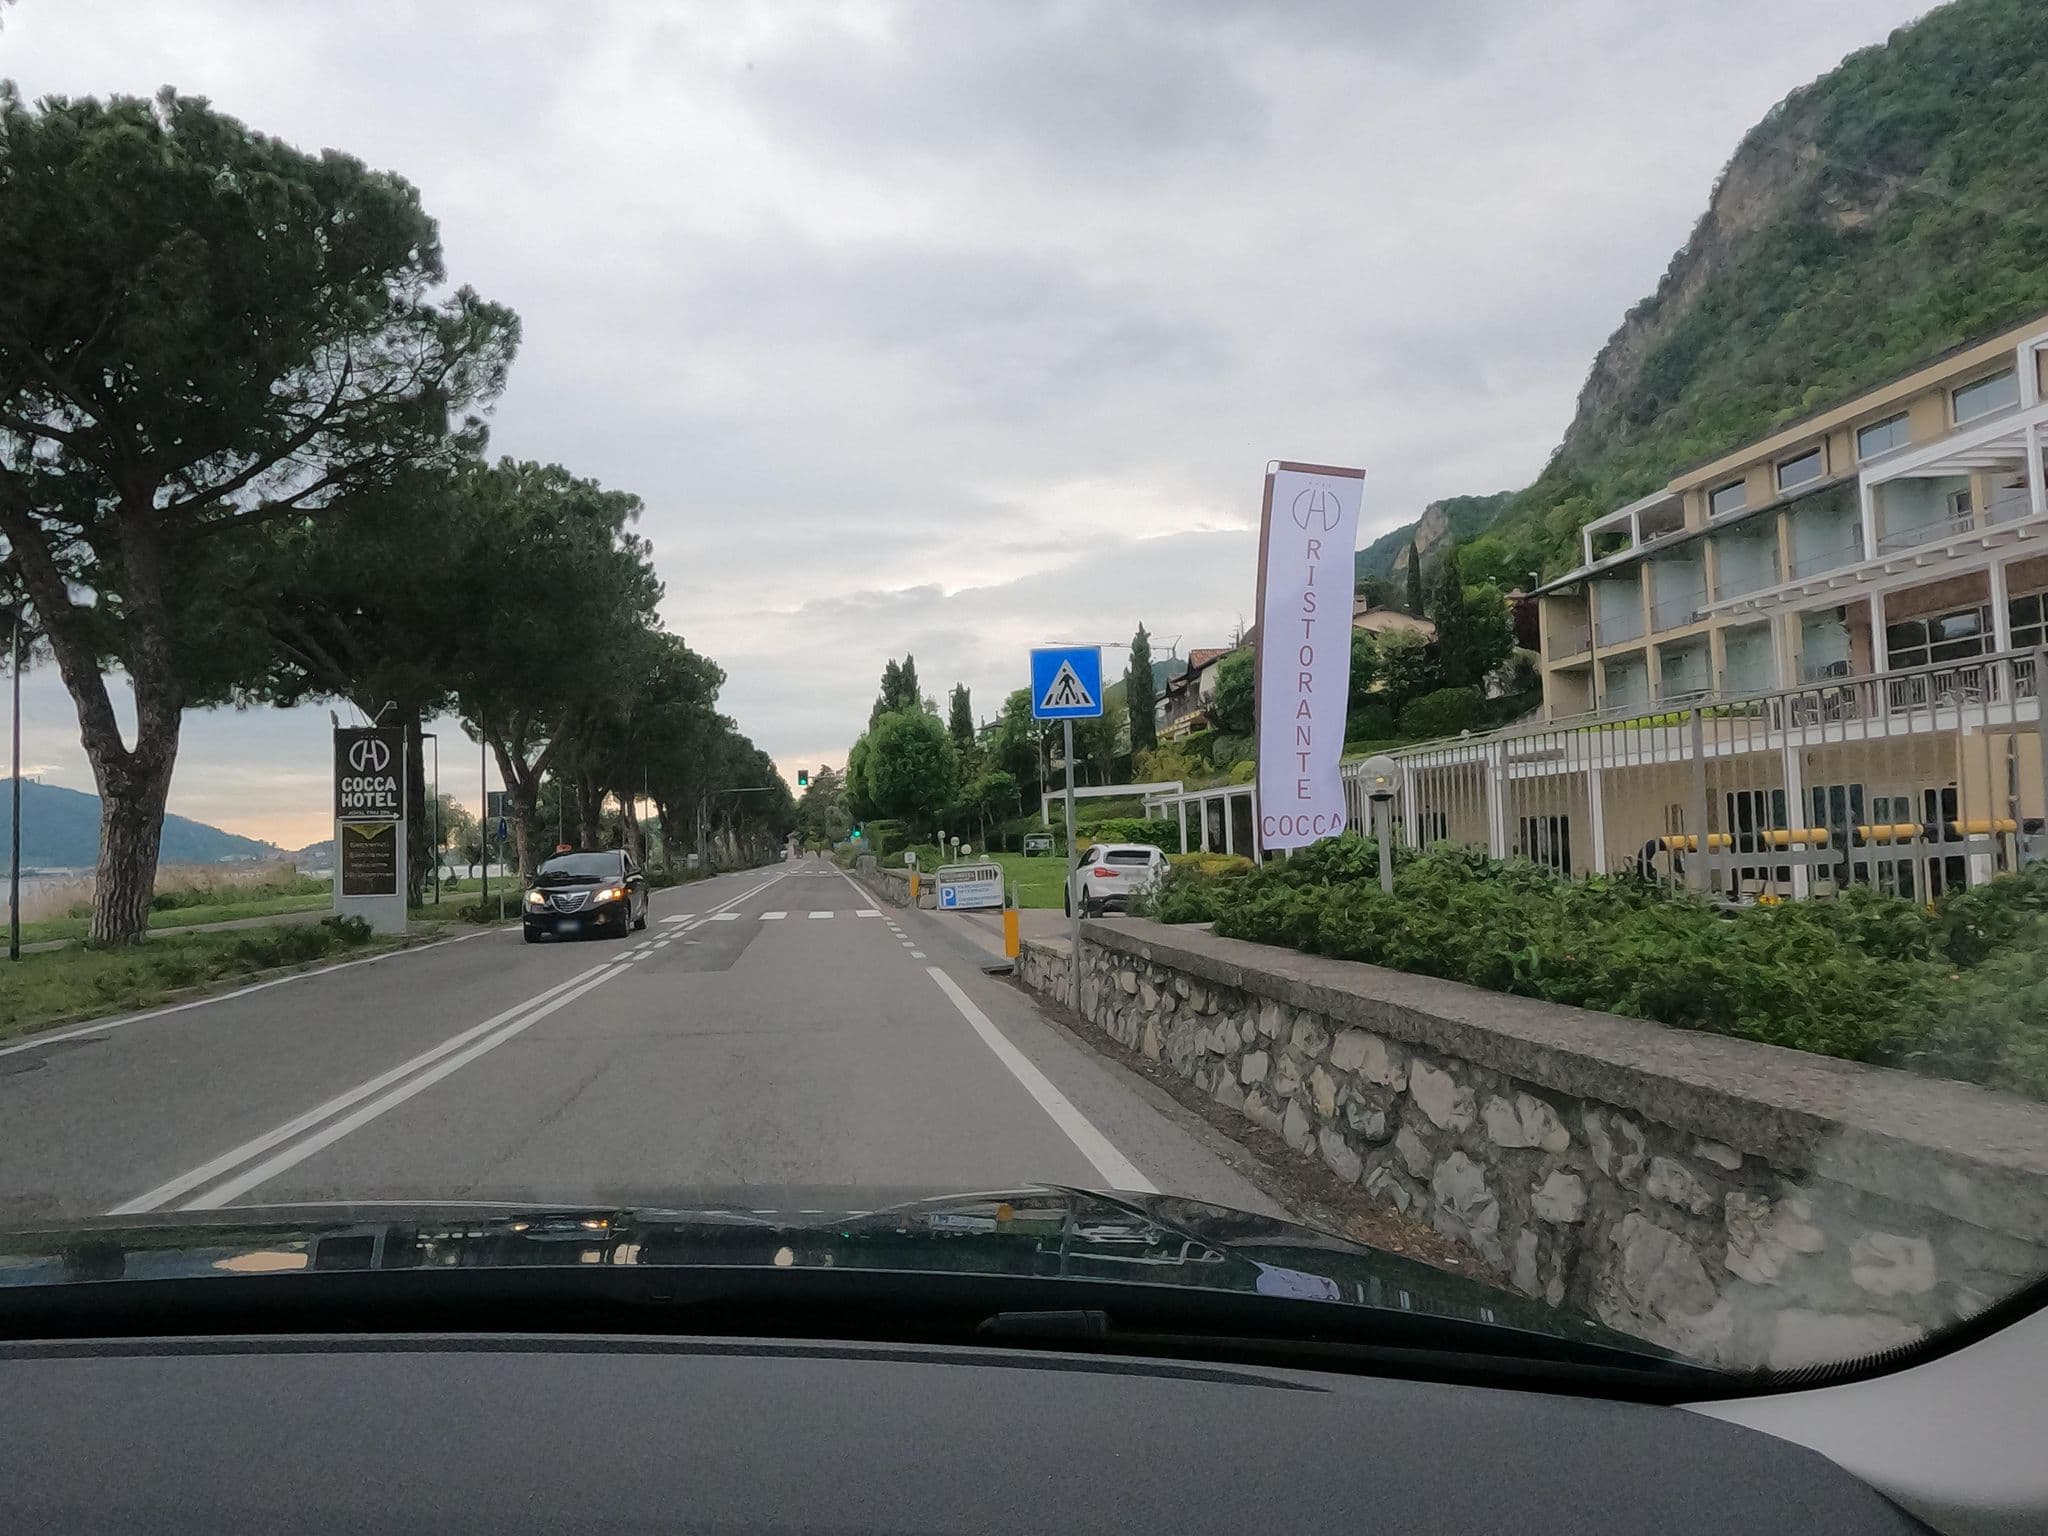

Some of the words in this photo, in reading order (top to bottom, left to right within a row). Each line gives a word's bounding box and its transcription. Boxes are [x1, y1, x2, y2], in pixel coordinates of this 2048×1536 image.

[1296, 538, 1322, 800] RISTORANTE
[341, 776, 397, 792] COCCA
[341, 792, 397, 808] HOTEL
[942, 888, 955, 906] P
